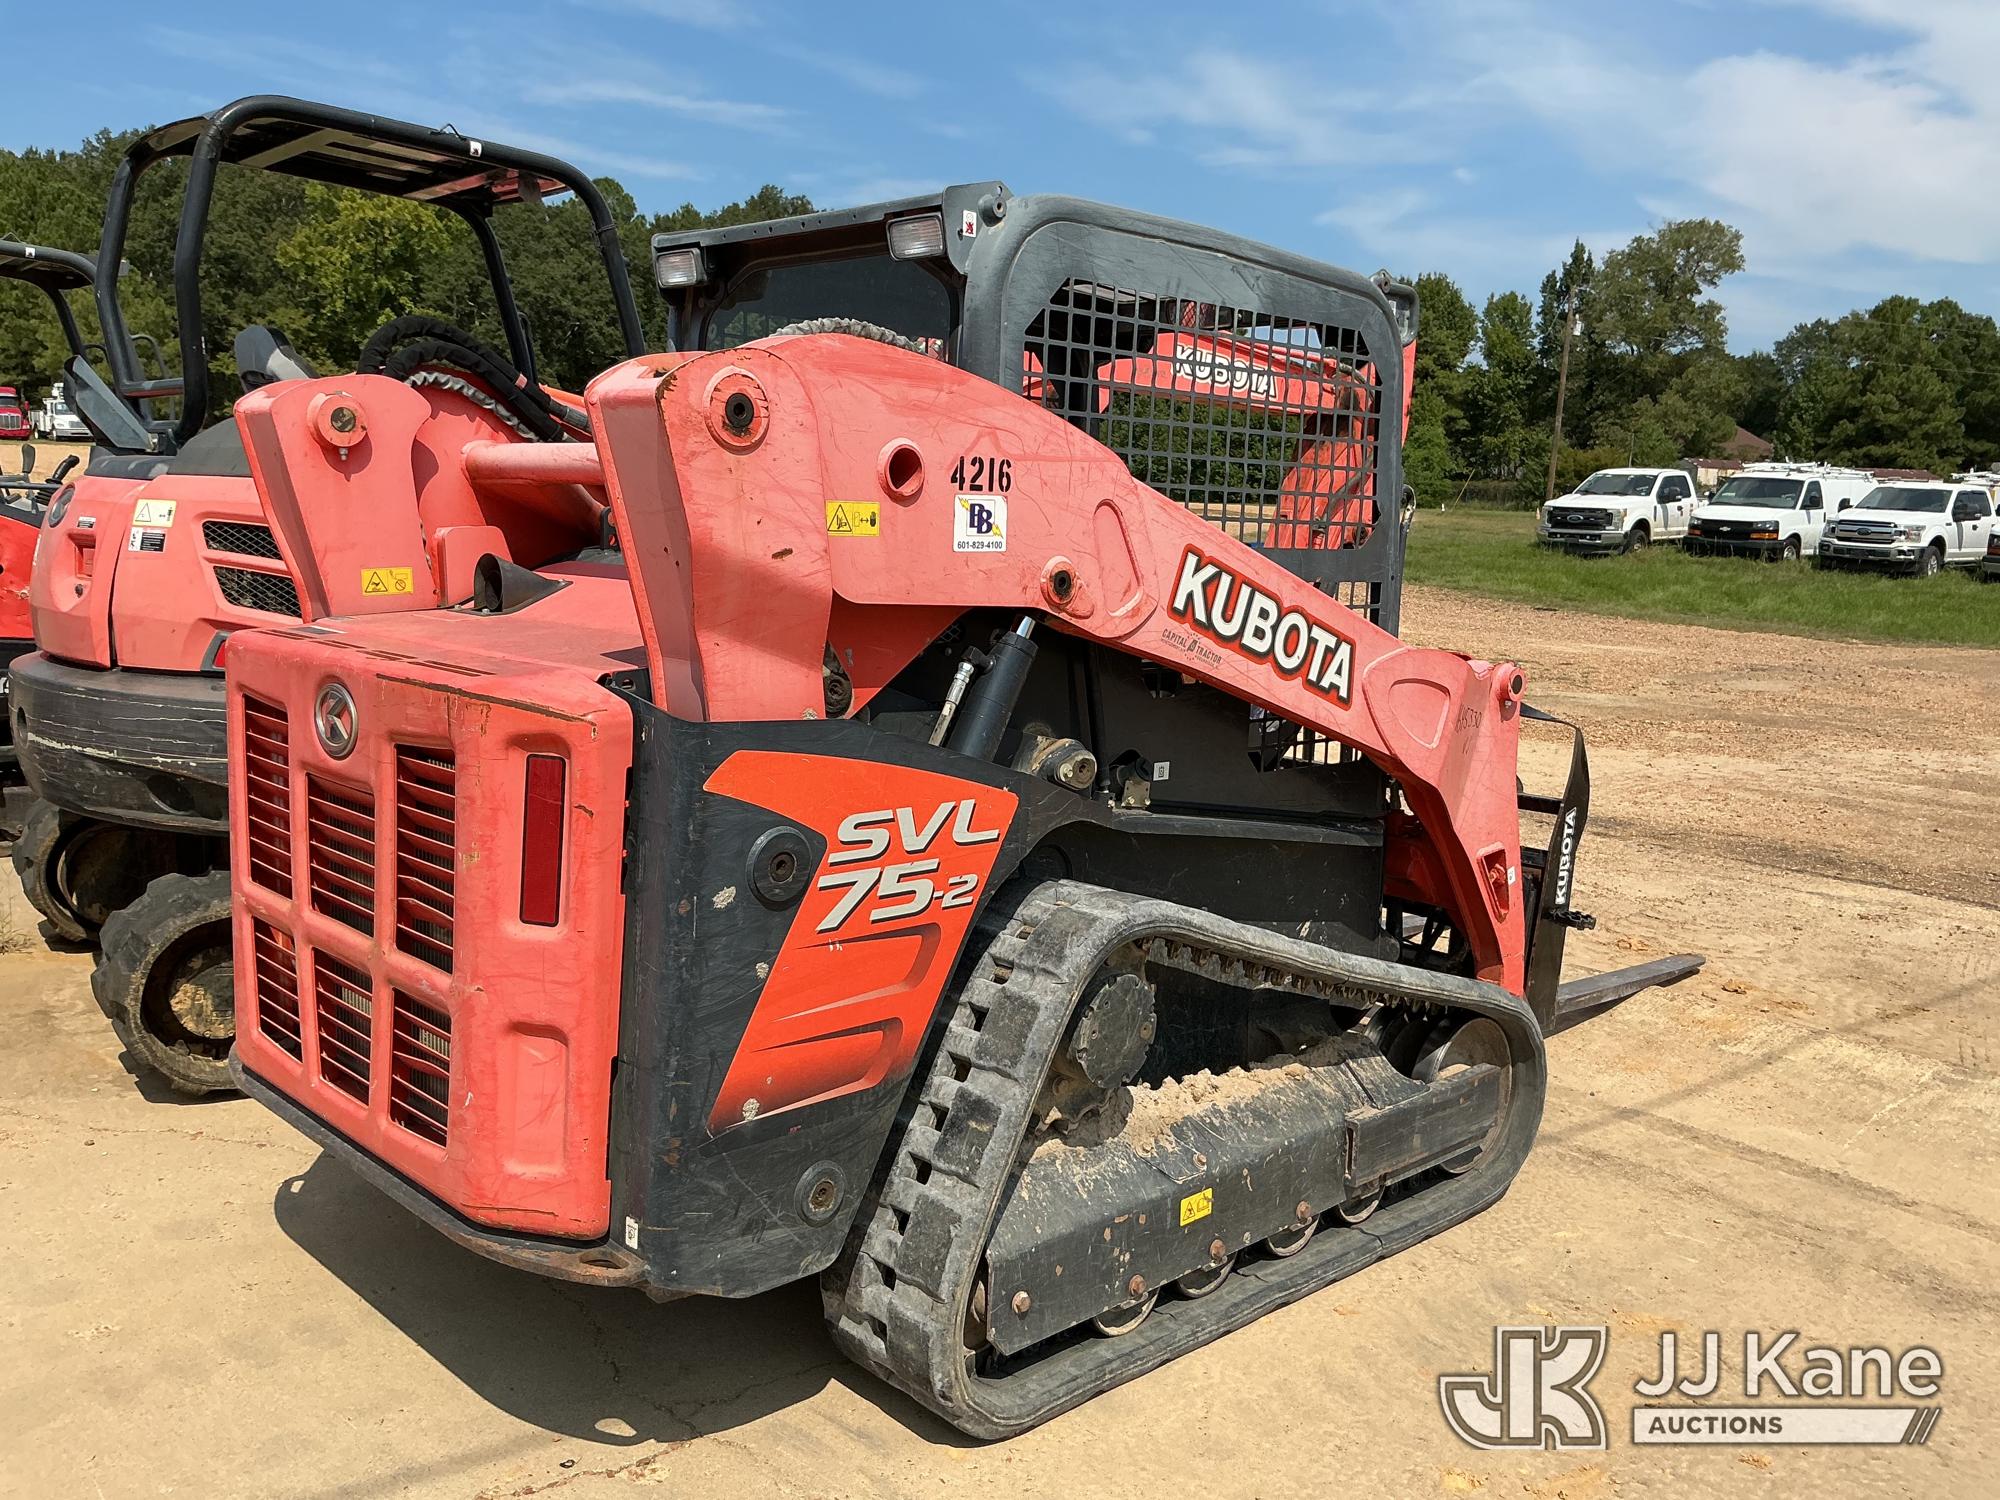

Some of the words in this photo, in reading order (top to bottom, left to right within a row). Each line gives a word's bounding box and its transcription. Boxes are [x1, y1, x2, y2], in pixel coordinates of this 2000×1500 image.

[1176, 344, 1277, 398] KUBOTA
[950, 455, 1012, 492] 4216
[957, 540, 1003, 550] 601-829-4100
[1161, 628, 1188, 648] CAPITAL
[1195, 645, 1223, 664] TRACTOR
[1172, 550, 1353, 702] KUBOTA
[827, 798, 1001, 866] SVL
[1554, 806, 1577, 905] KUBOTA
[815, 858, 979, 934] 75-2
